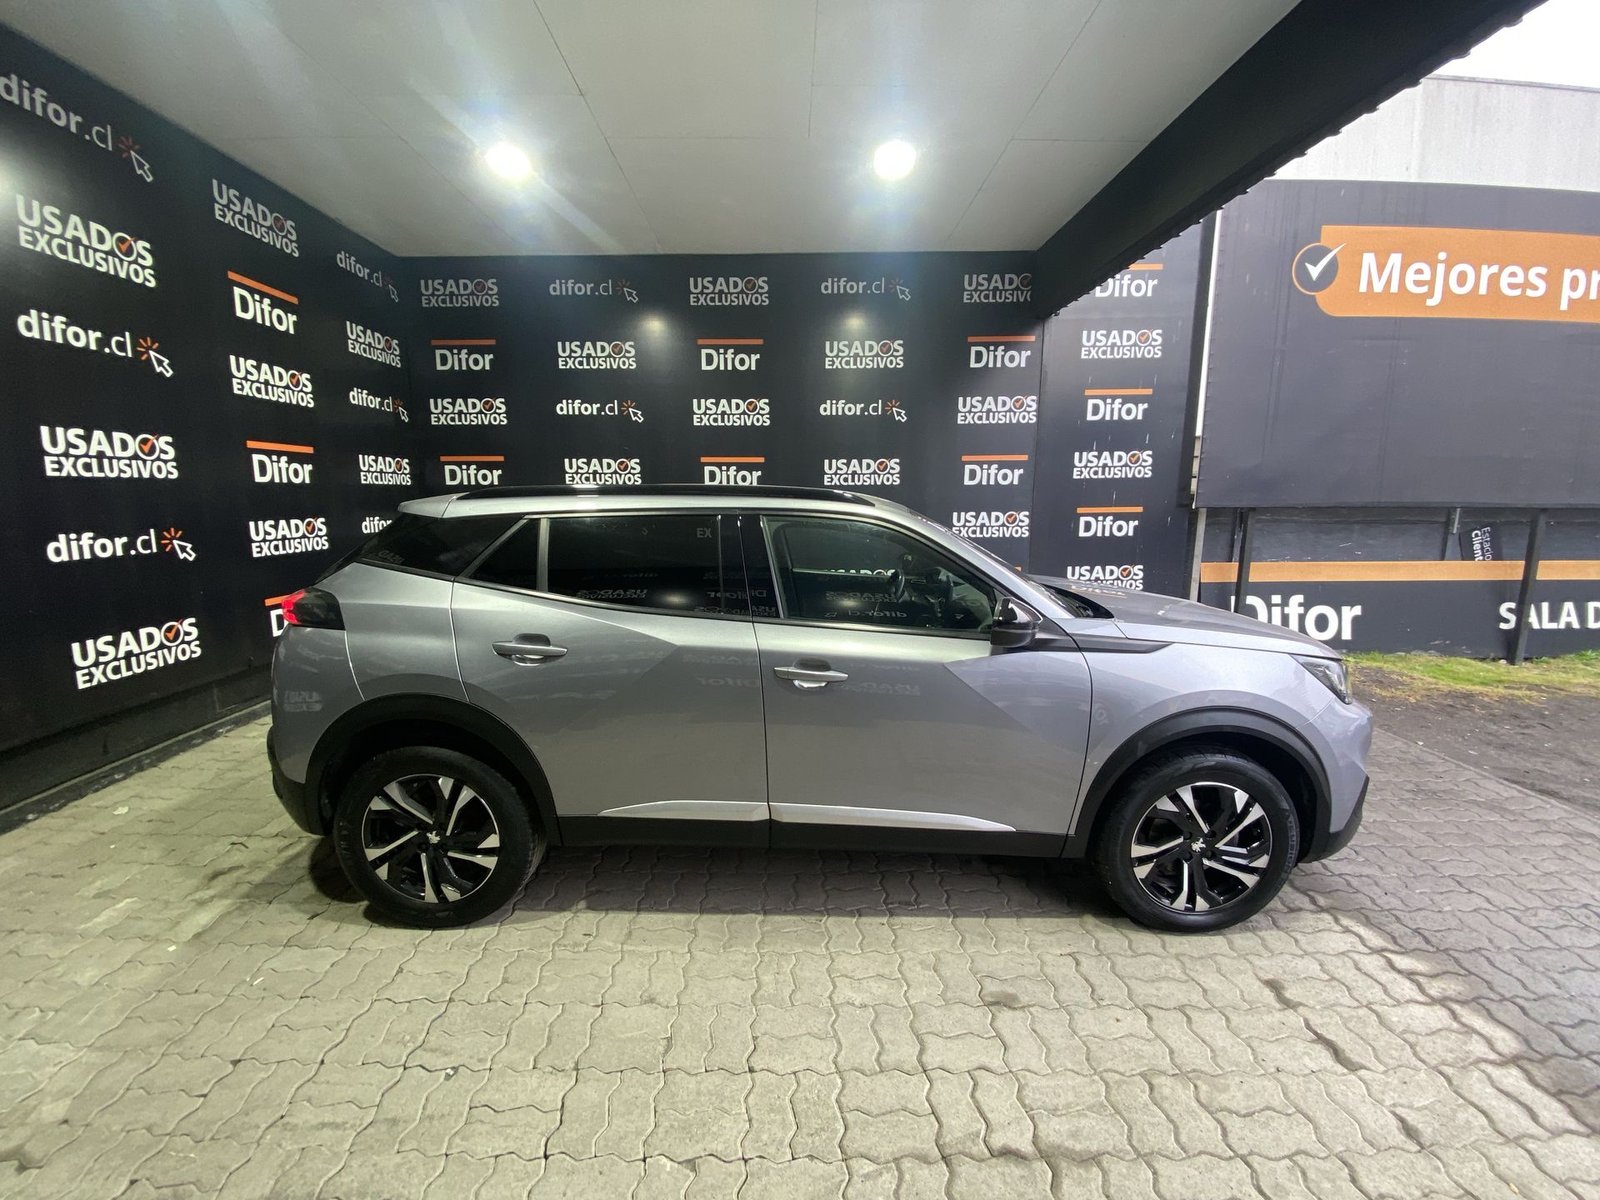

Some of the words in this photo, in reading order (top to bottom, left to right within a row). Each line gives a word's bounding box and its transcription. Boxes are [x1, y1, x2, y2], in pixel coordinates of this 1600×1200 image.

[0, 73, 113, 151] difor.cl
[212, 178, 297, 241] USADOS
[16, 193, 154, 267] USADOS
[214, 202, 299, 258] EXCLUSIVOS
[18, 225, 157, 288] EXCLUSIVOS
[336, 250, 383, 287] difor.cl
[420, 278, 498, 296] USADOS
[549, 279, 612, 296] difor.cl
[689, 276, 768, 294] USADOS
[820, 277, 885, 294] difor.cl
[1358, 251, 1548, 307] Mejores
[421, 295, 500, 307] EXCLUSIVOS
[690, 293, 769, 306] EXCLUSIVOS
[233, 286, 298, 335] Difor
[17, 309, 133, 358] difor.cl
[346, 321, 400, 355] USADOS
[1082, 329, 1163, 346] USADOS
[348, 340, 401, 368] EXCLUSIVOS
[557, 341, 636, 357] USADOS
[825, 339, 904, 357] USADOS
[969, 346, 1031, 368] Difor
[1080, 346, 1162, 359] EXCLUSIVOS
[435, 349, 494, 371] Difor
[558, 357, 637, 370] EXCLUSIVOS
[700, 348, 761, 371] Difor
[825, 357, 904, 370] EXCLUSIVOS
[229, 355, 313, 392] USADOS
[232, 378, 315, 408] EXCLUSIVOS
[349, 387, 393, 412] difor.cl
[429, 398, 506, 413] USADOS
[555, 399, 618, 416] difor.cl
[692, 398, 770, 415] USADOS
[819, 399, 882, 416] difor.cl
[957, 395, 1037, 412] USADOS
[1086, 399, 1149, 421] Difor
[430, 413, 508, 425] EXCLUSIVOS
[693, 414, 771, 426] EXCLUSIVOS
[957, 411, 1037, 424] EXCLUSIVOS
[40, 425, 176, 460] USADOS
[44, 456, 179, 479] EXCLUSIVOS
[251, 453, 313, 484] Difor
[358, 454, 410, 473] USADOS
[564, 458, 641, 474] USADOS
[824, 458, 900, 474] USADOS
[1073, 450, 1153, 467] USADOS
[360, 472, 411, 486] EXCLUSIVOS
[444, 464, 502, 486] Difor
[565, 473, 642, 485] EXCLUSIVOS
[704, 465, 762, 486] Difor
[823, 474, 900, 486] EXCLUSIVOS
[963, 464, 1024, 486] Difor
[1072, 466, 1152, 479] EXCLUSIVOS
[249, 517, 327, 541] USADOS
[952, 511, 1030, 527] USADOS
[1078, 516, 1139, 537] Difor
[46, 528, 158, 563] difor.cl
[251, 536, 329, 558] EXCLUSIVOS
[1066, 565, 1144, 581] USADOS
[71, 617, 199, 667] USADOS
[75, 640, 202, 690] EXCLUSIVOS
